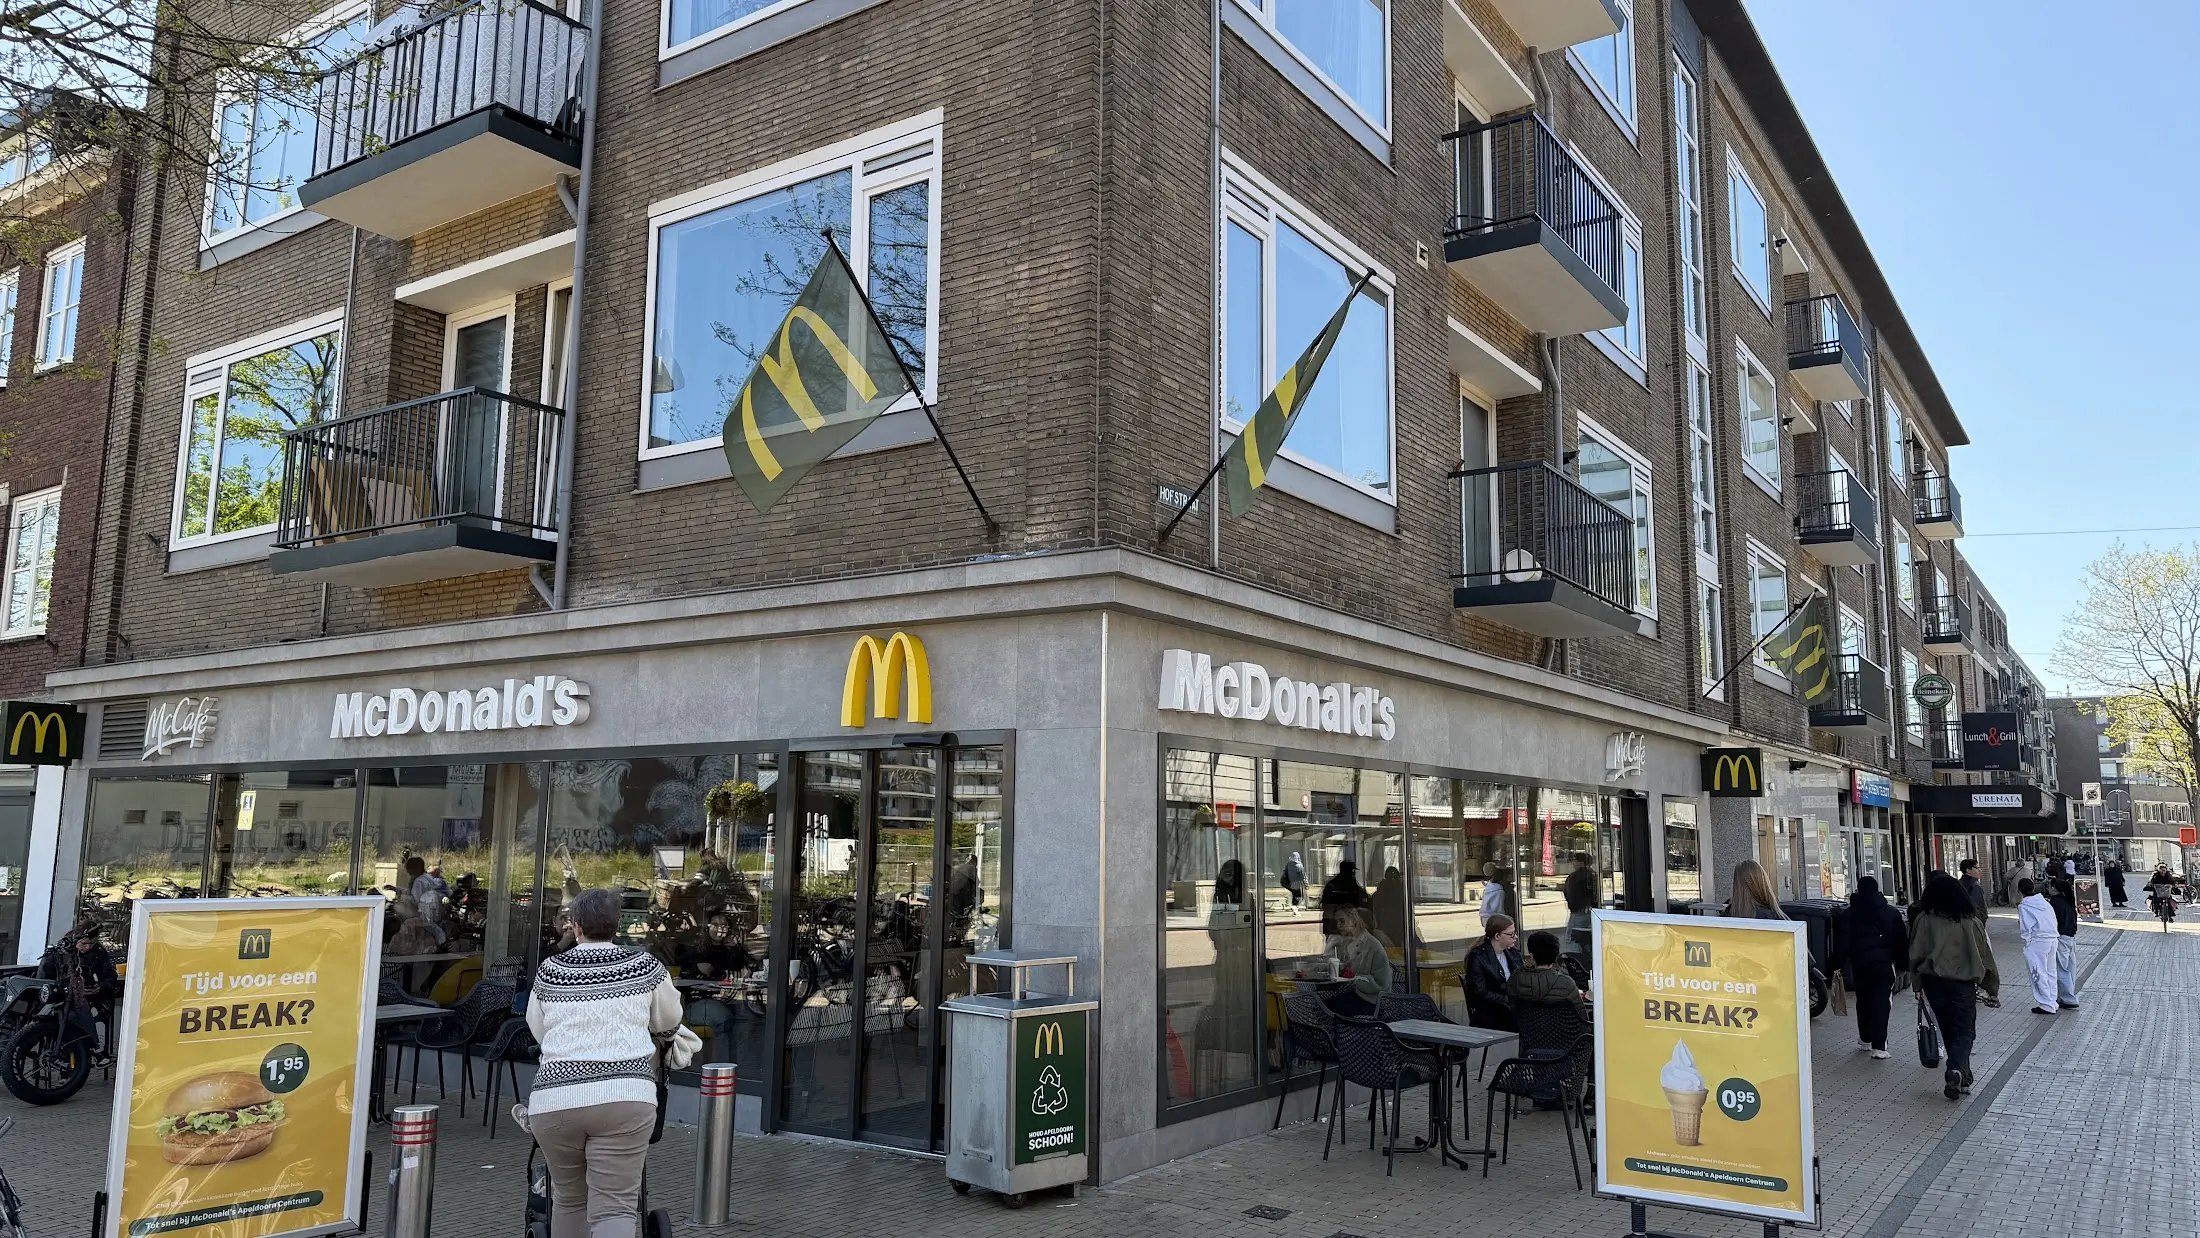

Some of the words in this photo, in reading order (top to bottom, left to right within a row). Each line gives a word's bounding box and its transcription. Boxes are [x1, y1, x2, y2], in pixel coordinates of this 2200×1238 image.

[1158, 649, 1396, 741] McDonald's
[1916, 688, 1949, 696] Heineken
[330, 675, 588, 738] McDonald's
[143, 696, 214, 757] McCafé
[1612, 731, 1646, 779] McCafé
[1973, 795, 2021, 804] SERENATA
[181, 971, 224, 995] Tijd
[228, 972, 277, 989] voor
[280, 971, 317, 985] een
[1641, 971, 1676, 991] Tijd
[1679, 977, 1720, 992] voor
[1723, 981, 1758, 995] een
[179, 999, 315, 1034] BREAK?
[1644, 998, 1759, 1029] BREAK?
[266, 1056, 304, 1084] 1,95
[1721, 1089, 1756, 1113] 0,95
[1028, 1130, 1044, 1139] HOUD
[1044, 1125, 1074, 1136] APELDOORN
[1028, 1132, 1074, 1150] SCHOON!
[1636, 1161, 1647, 1170] Tot
[1647, 1162, 1661, 1171] snel
[1661, 1164, 1671, 1174] bij
[1671, 1166, 1710, 1178] McDonald's
[1710, 1172, 1744, 1184] Apeldoorn
[1745, 1177, 1775, 1187] Centrum
[145, 1221, 160, 1230] Tot
[161, 1218, 178, 1228] snel
[179, 1216, 190, 1226] bij
[191, 1208, 237, 1223] McDonald's
[237, 1200, 278, 1216] Apeldoorn
[277, 1195, 310, 1209] Centrum
